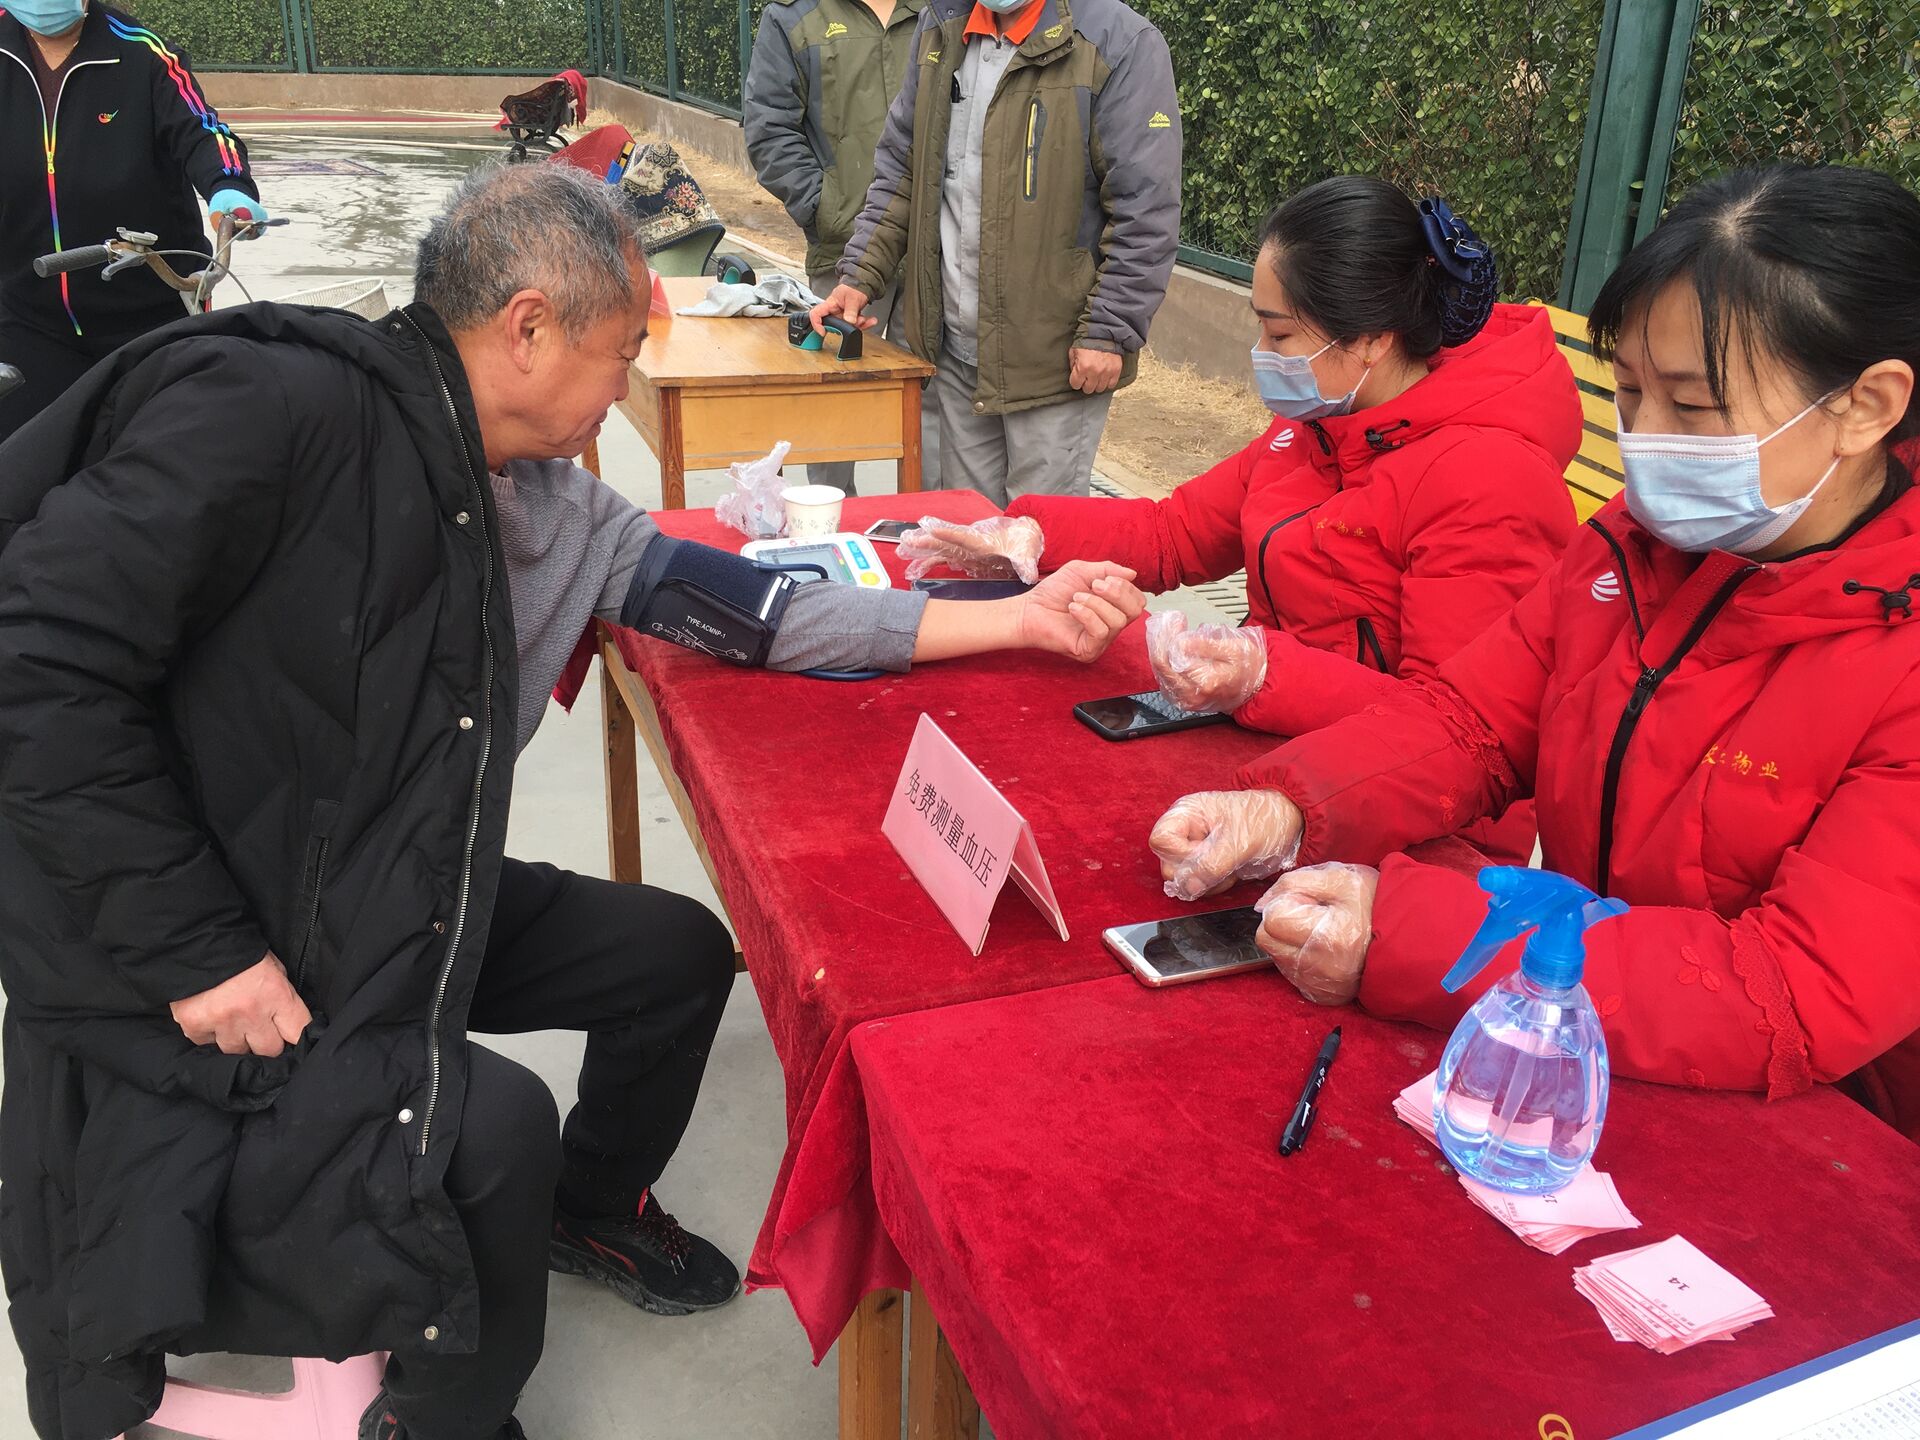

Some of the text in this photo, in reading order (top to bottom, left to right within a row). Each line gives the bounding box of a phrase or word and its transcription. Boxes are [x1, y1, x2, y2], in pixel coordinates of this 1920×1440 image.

[904, 768, 998, 888] 免费测量血压
[1668, 1277, 1690, 1291] 14
